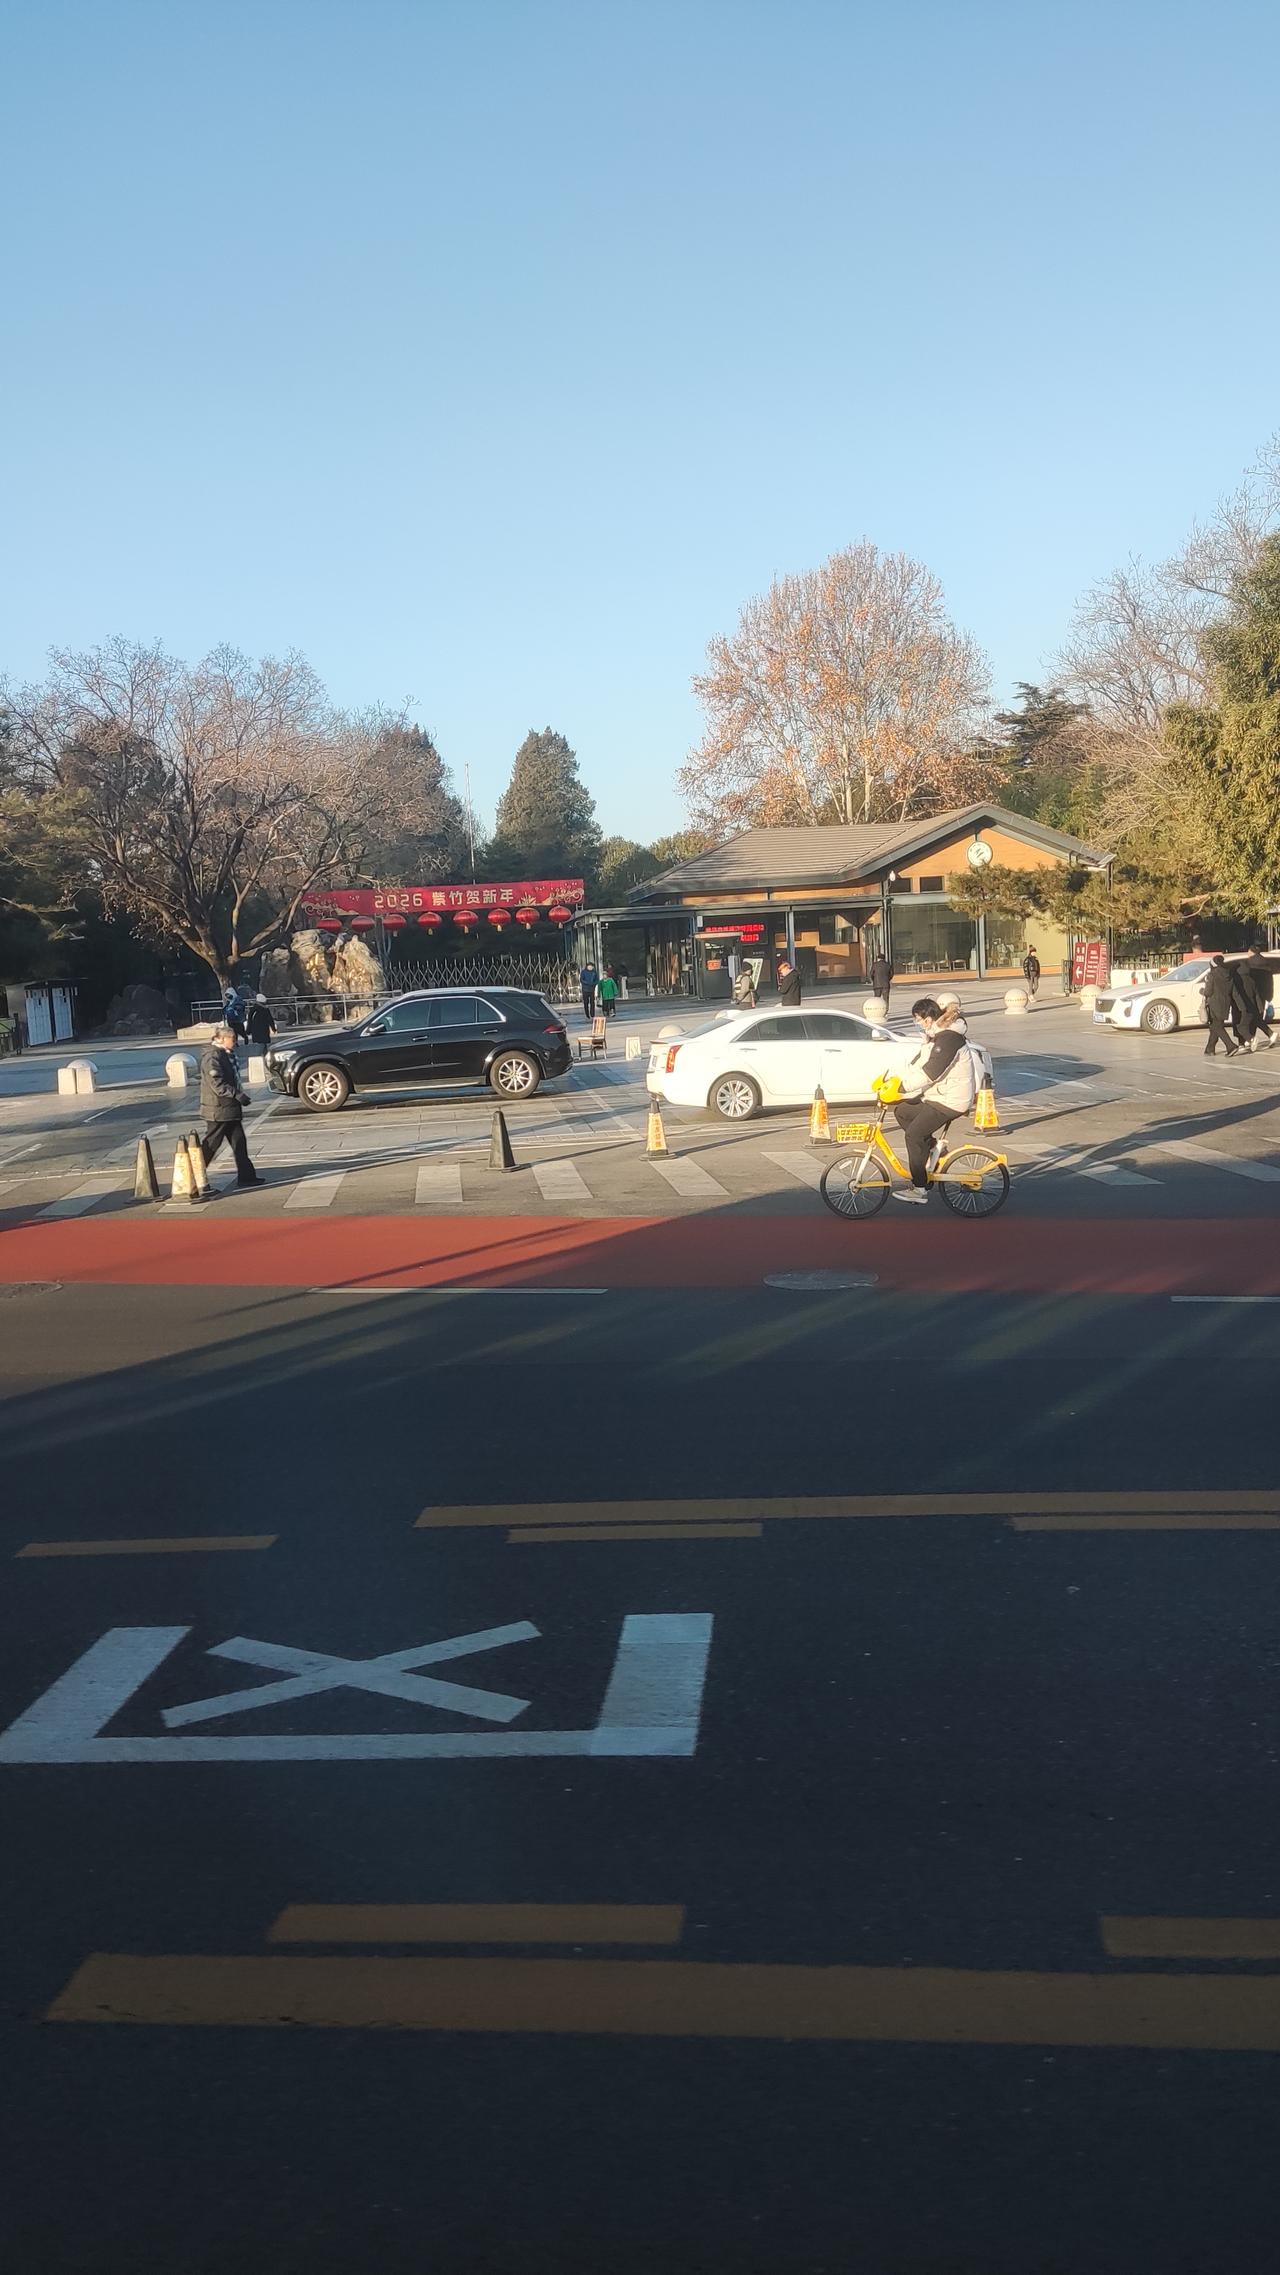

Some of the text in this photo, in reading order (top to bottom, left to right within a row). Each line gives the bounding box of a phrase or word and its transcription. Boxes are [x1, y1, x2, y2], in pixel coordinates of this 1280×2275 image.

[374, 888, 514, 909] 2026 紫竹贺新年
